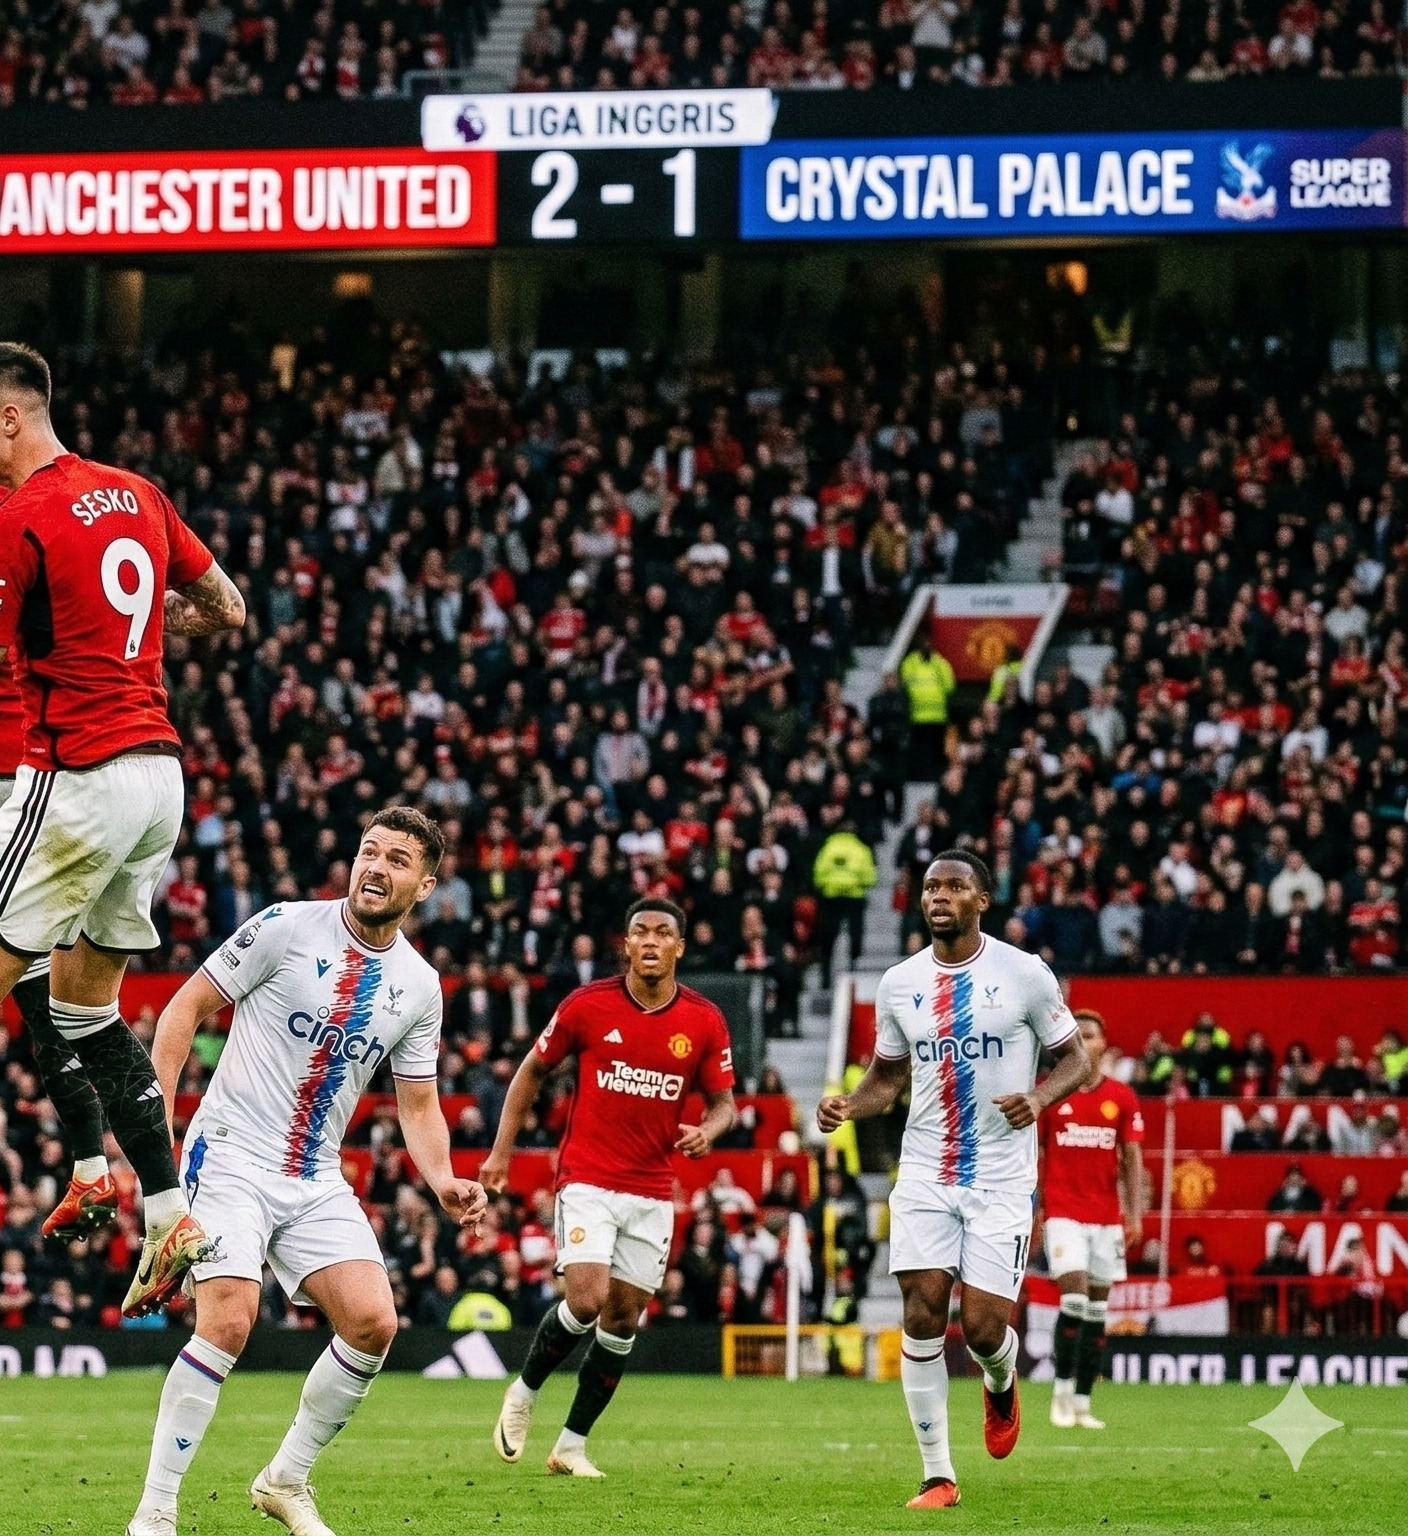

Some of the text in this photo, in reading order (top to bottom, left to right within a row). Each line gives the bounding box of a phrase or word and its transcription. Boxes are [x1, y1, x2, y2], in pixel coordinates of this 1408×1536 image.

[508, 102, 736, 138] LIGA INGGRIS
[765, 148, 1192, 223] CRYSTAL PALACE
[1290, 157, 1392, 186] SUPER
[292, 165, 472, 231] UNITED
[530, 150, 580, 239] 2
[662, 148, 697, 237] 1
[71, 488, 139, 526] SESKO
[100, 536, 155, 661] 9
[287, 1006, 386, 1070] cinch
[915, 1027, 1004, 1062] cinch
[596, 1069, 661, 1099] Viewer
[610, 1060, 663, 1086] Team
